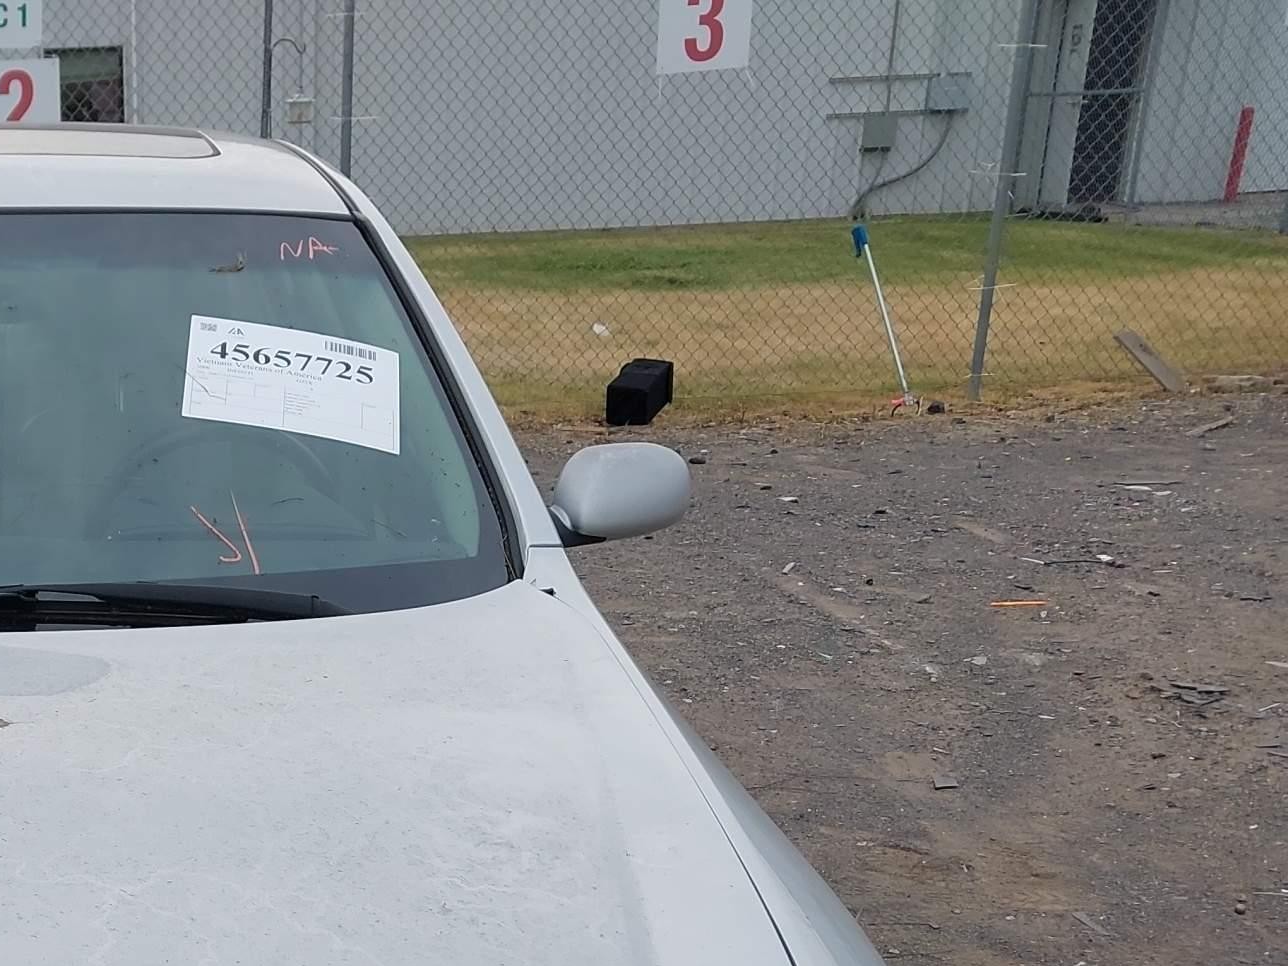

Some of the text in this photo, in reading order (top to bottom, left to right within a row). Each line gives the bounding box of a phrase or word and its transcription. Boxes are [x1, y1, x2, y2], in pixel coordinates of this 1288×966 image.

[17, 3, 27, 28] 1
[684, 0, 725, 62] 3
[210, 341, 374, 385] 45657725
